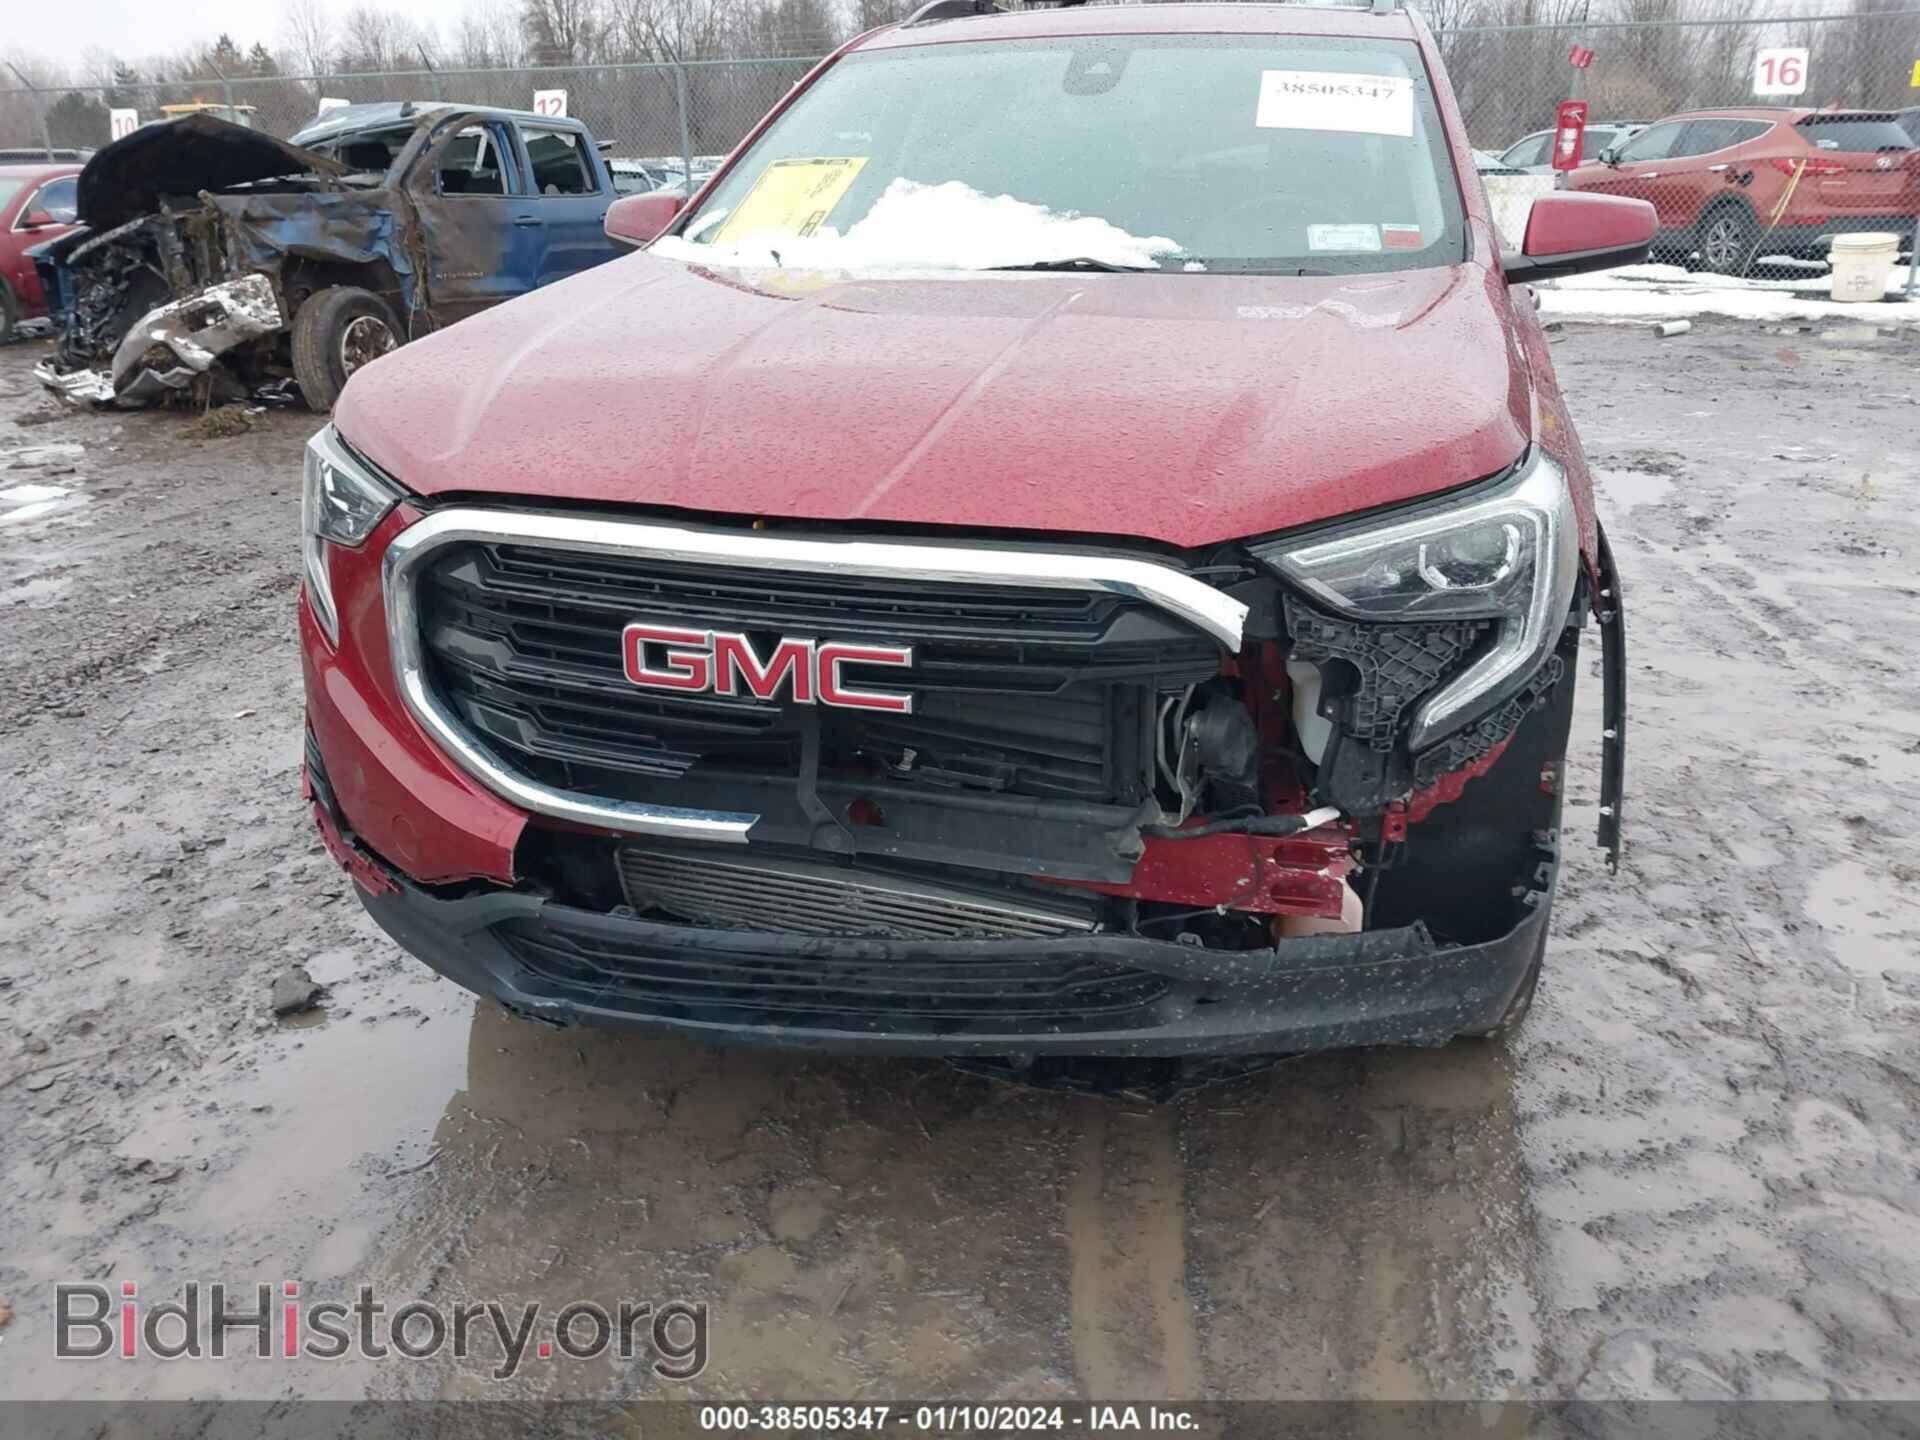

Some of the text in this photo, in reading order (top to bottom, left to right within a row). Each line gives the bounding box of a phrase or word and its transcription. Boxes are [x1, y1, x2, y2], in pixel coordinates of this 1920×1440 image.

[1760, 57, 1802, 87] 16
[1277, 82, 1396, 98] 38505347
[537, 97, 562, 116] 12
[622, 623, 912, 714] GMC
